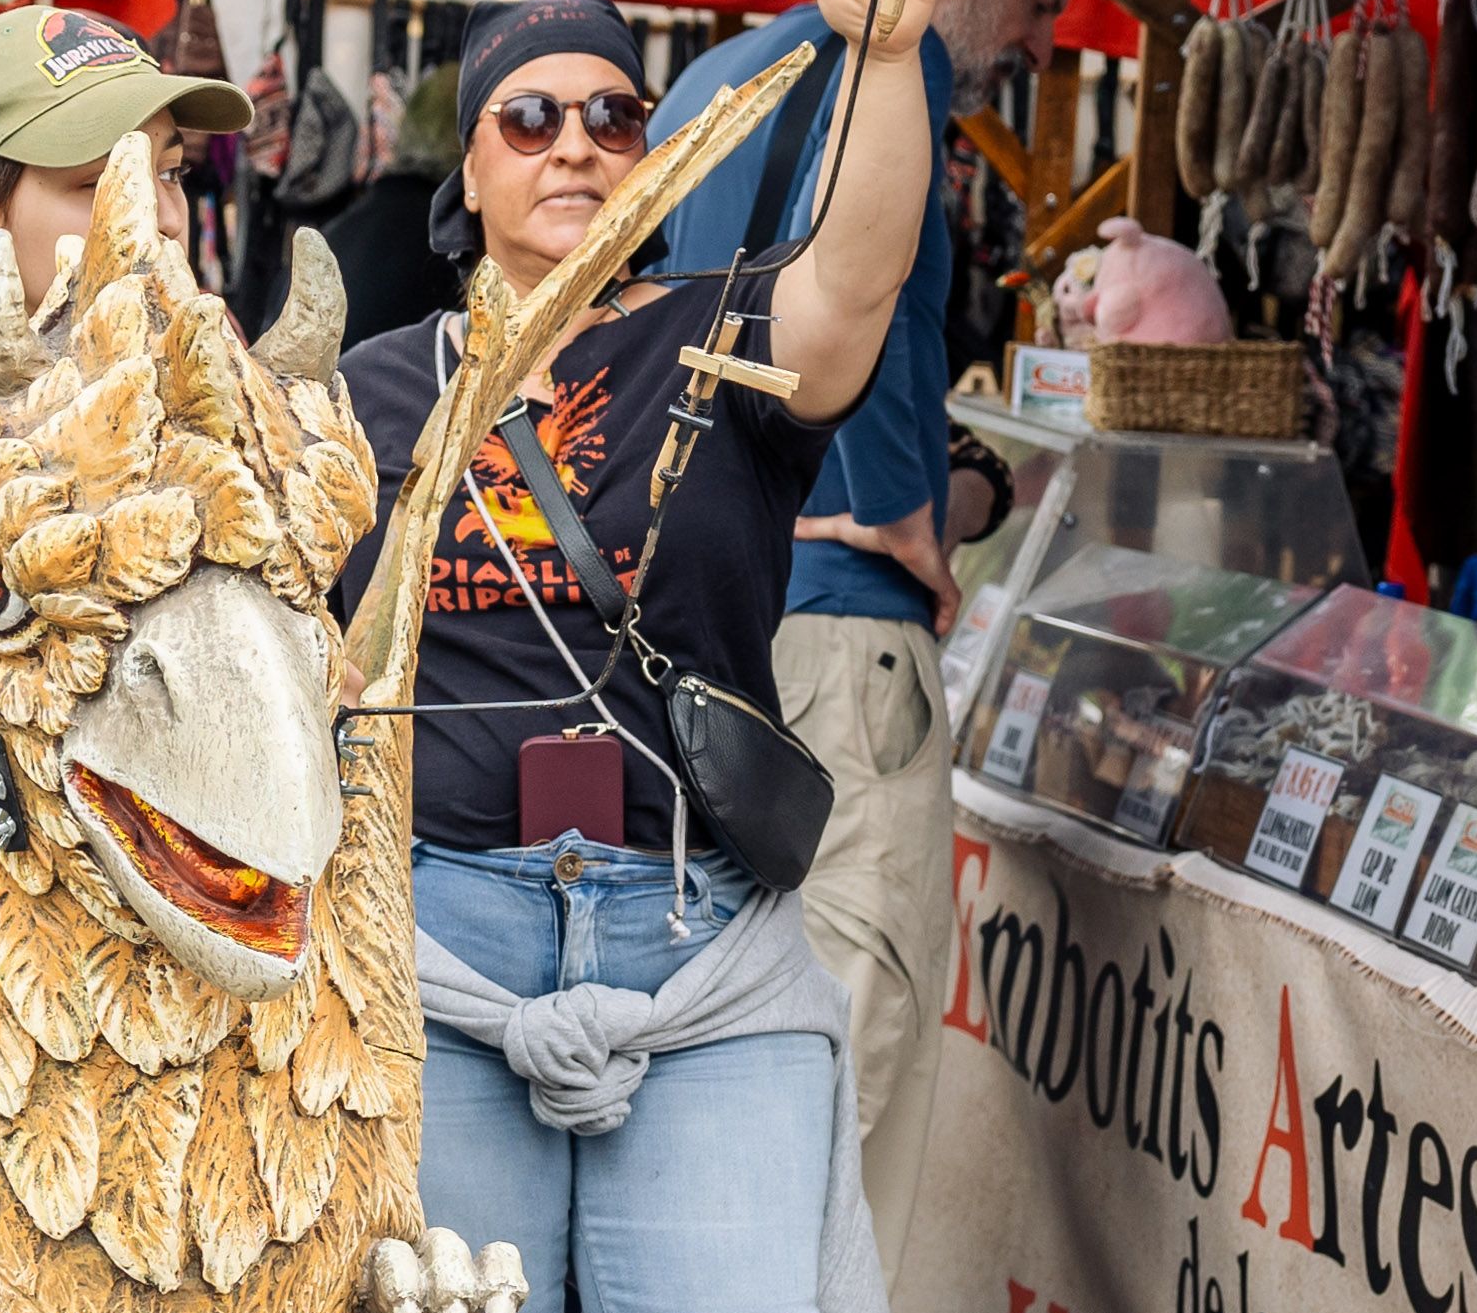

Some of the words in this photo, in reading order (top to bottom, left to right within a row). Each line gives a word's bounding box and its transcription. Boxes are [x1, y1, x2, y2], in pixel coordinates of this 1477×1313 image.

[1360, 847, 1383, 878] CAP
[1424, 873, 1456, 909] LLOM
[942, 832, 1224, 1198] Embotits
